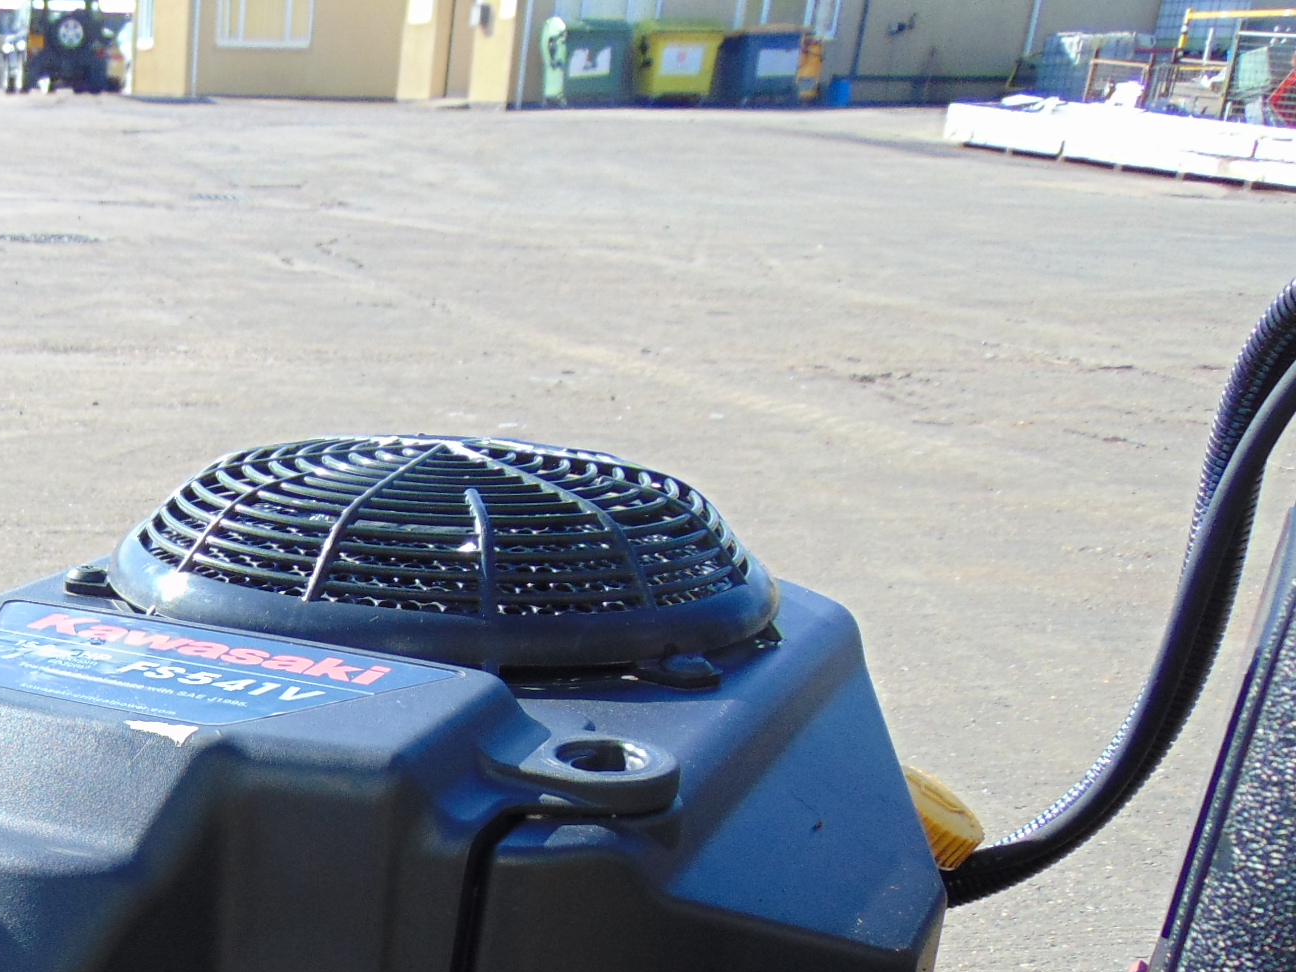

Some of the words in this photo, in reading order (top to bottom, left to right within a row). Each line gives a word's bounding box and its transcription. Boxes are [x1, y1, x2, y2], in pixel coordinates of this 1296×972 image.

[27, 613, 392, 685] Kawasaki
[116, 661, 326, 701] FS541V
[177, 690, 207, 700] SAE
